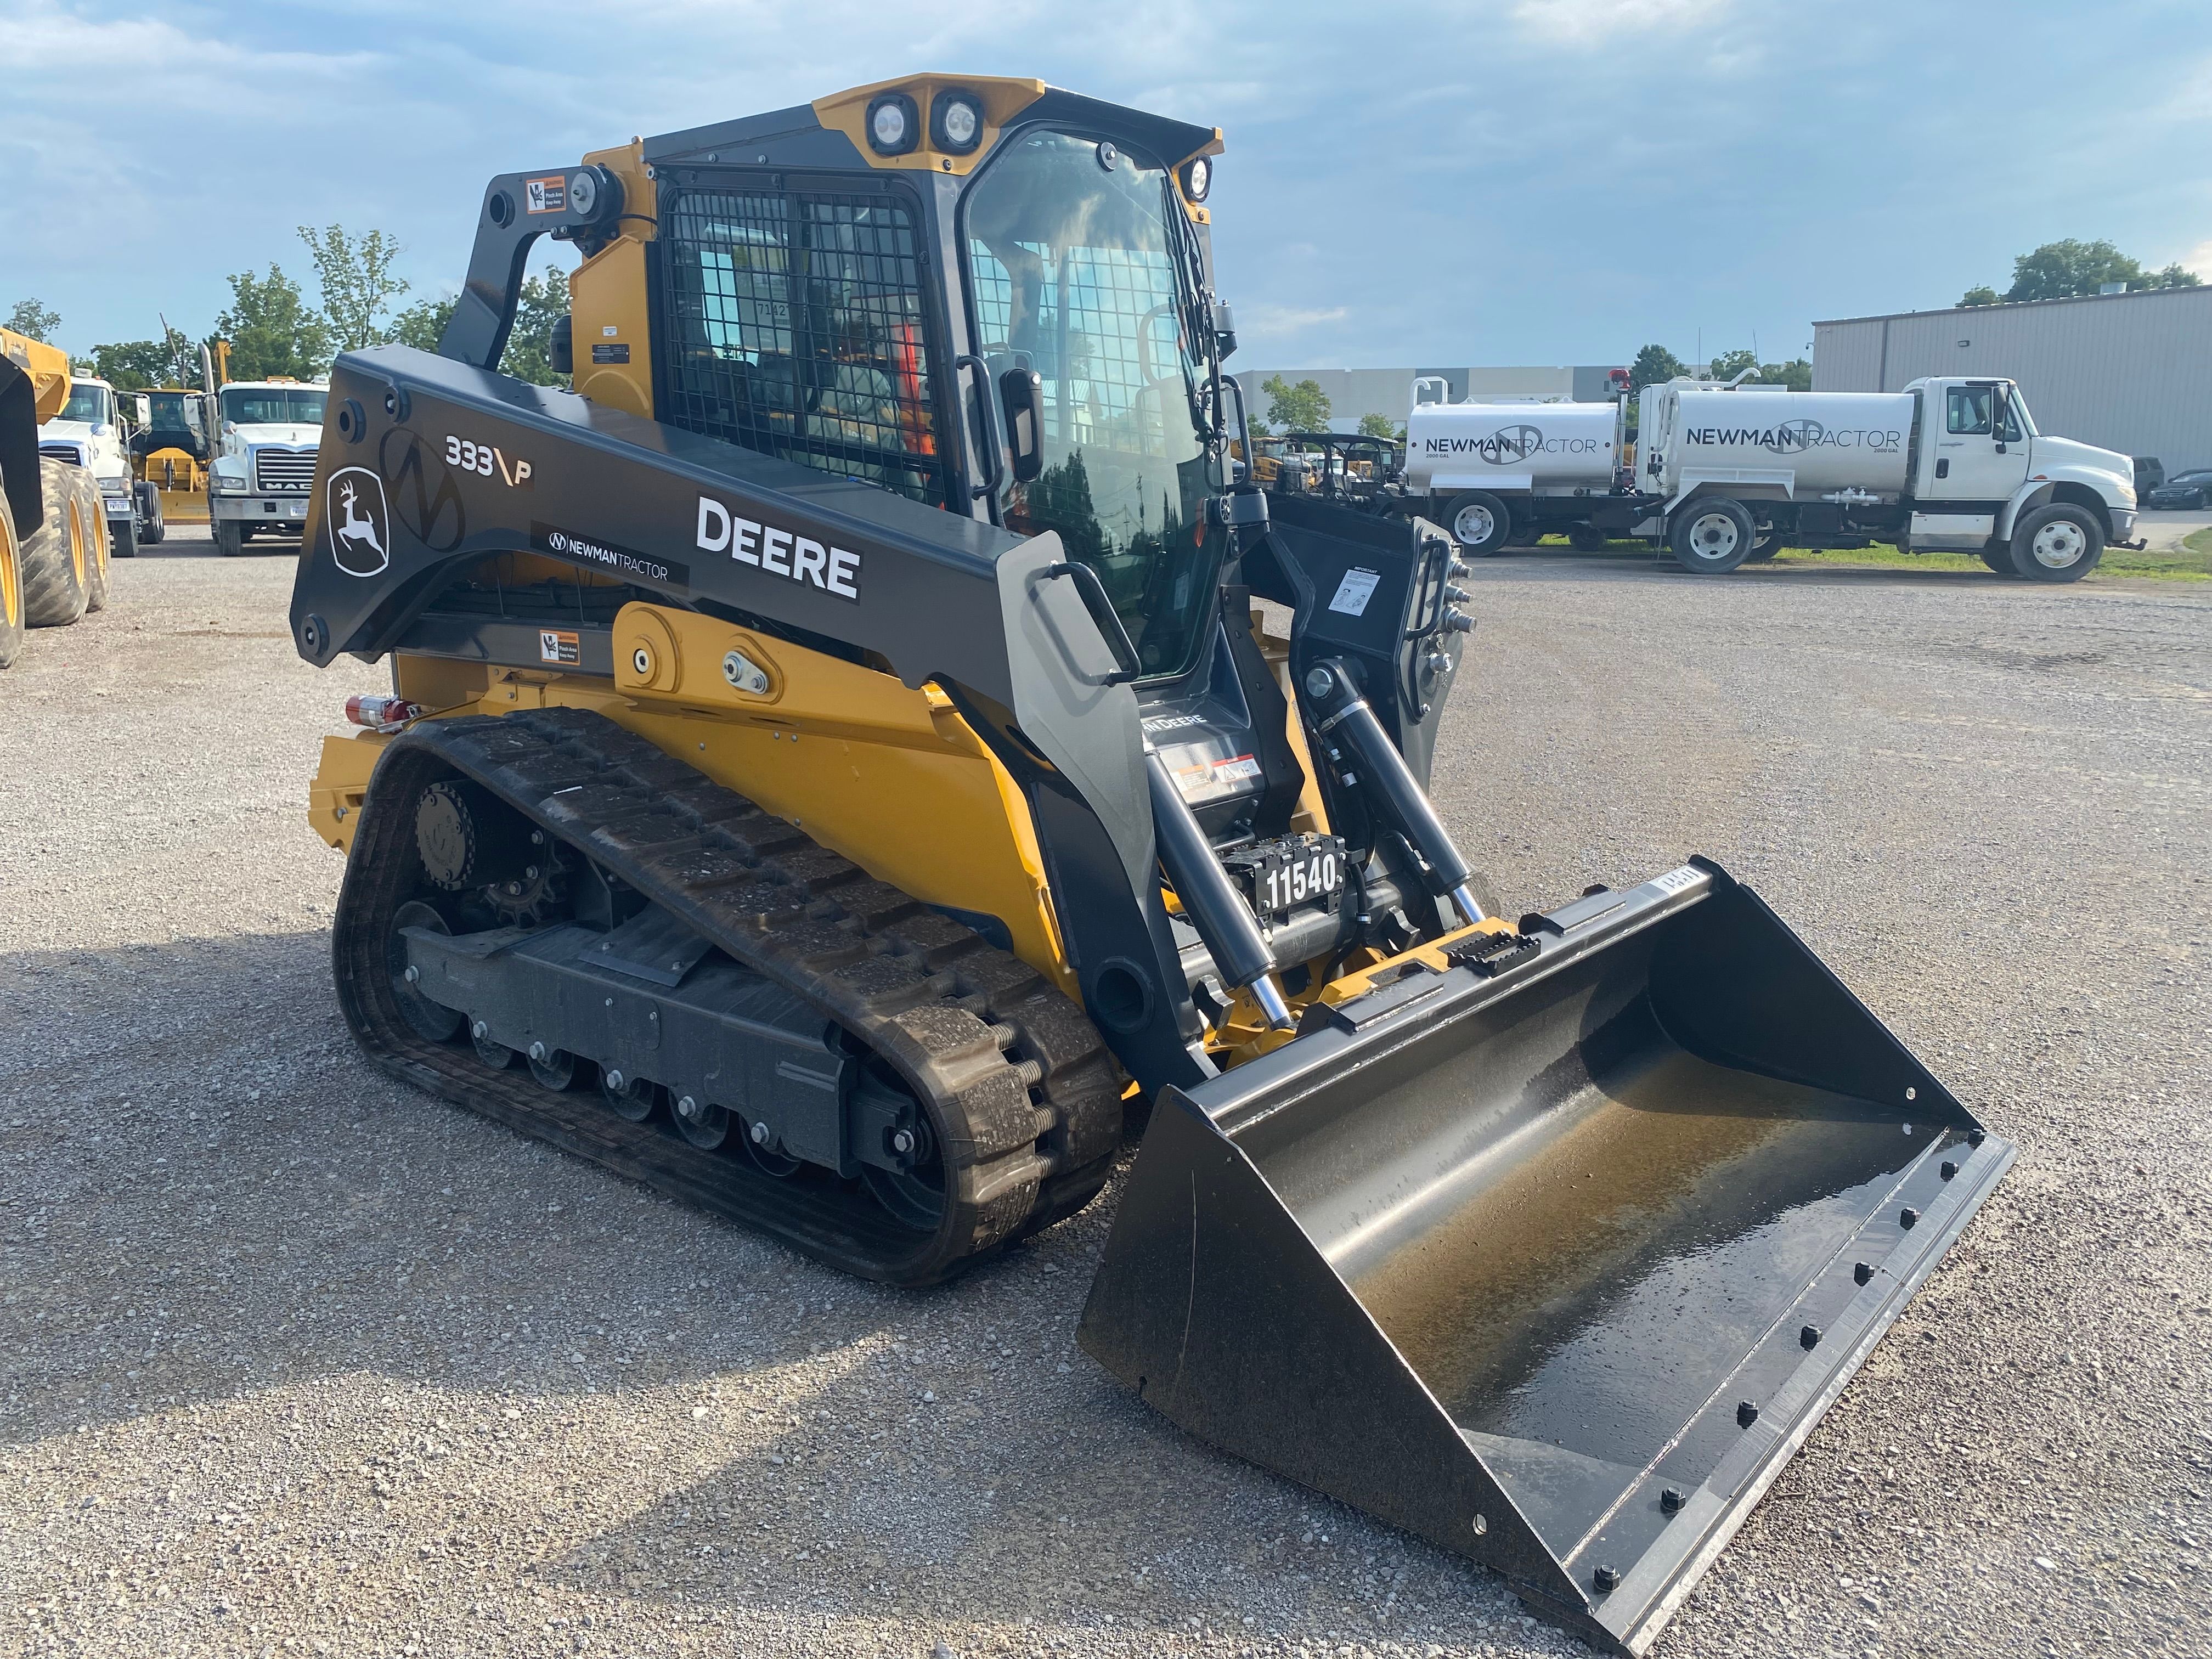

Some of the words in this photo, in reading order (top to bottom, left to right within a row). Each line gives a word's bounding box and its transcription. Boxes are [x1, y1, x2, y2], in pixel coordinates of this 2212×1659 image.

[697, 496, 860, 599] DEERE
[1155, 714, 1207, 729] DEERE
[1267, 854, 1336, 909] 11540
